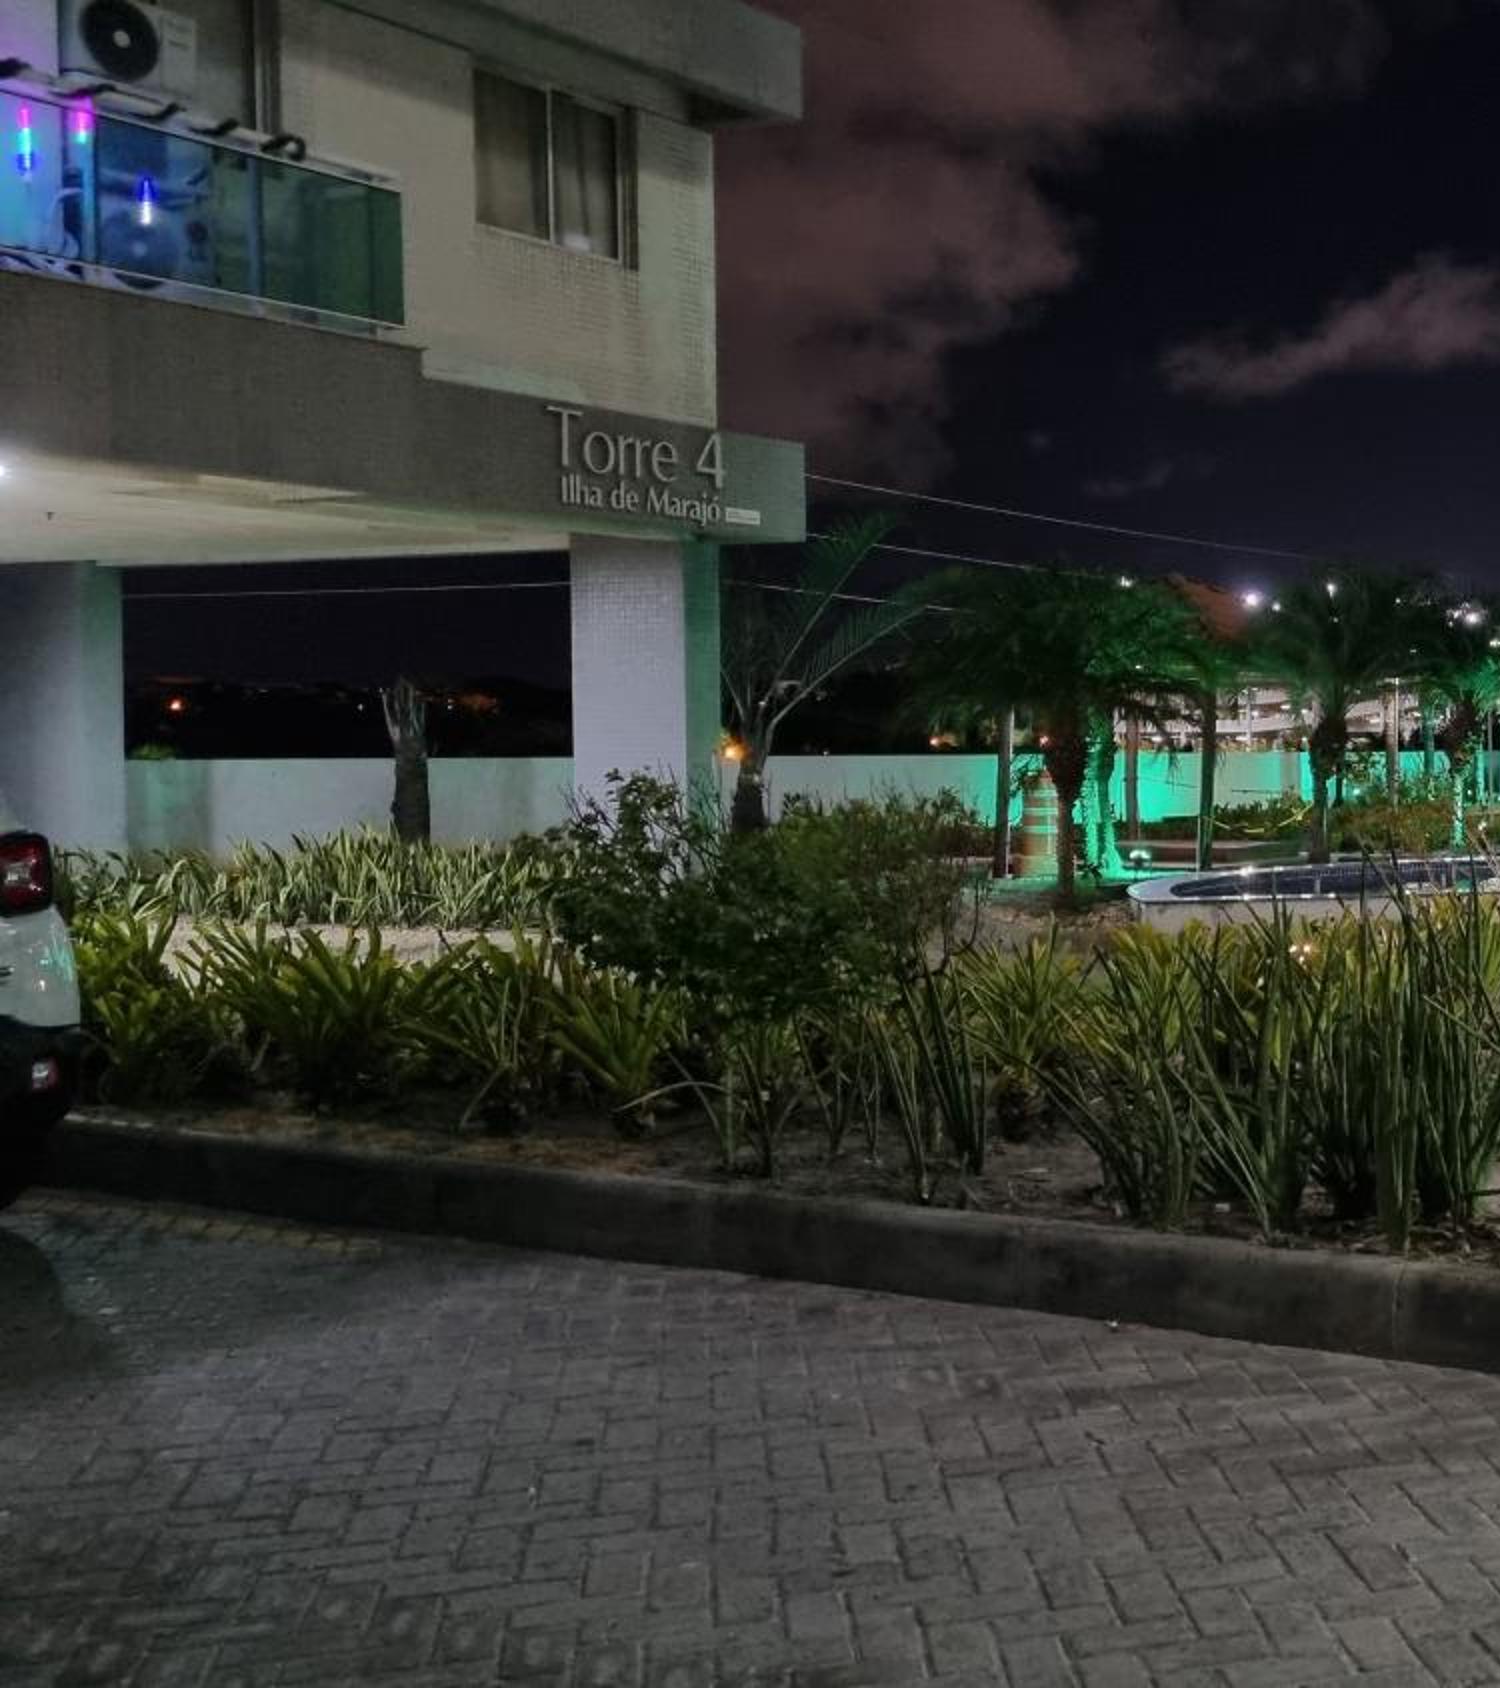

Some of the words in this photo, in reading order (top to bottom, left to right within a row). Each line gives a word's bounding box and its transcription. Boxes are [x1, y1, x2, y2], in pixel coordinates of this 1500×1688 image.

[547, 405, 678, 482] Torre
[696, 432, 726, 489] 4
[561, 474, 603, 506] Ilha
[610, 480, 640, 512] de
[646, 487, 721, 526] Marajó
